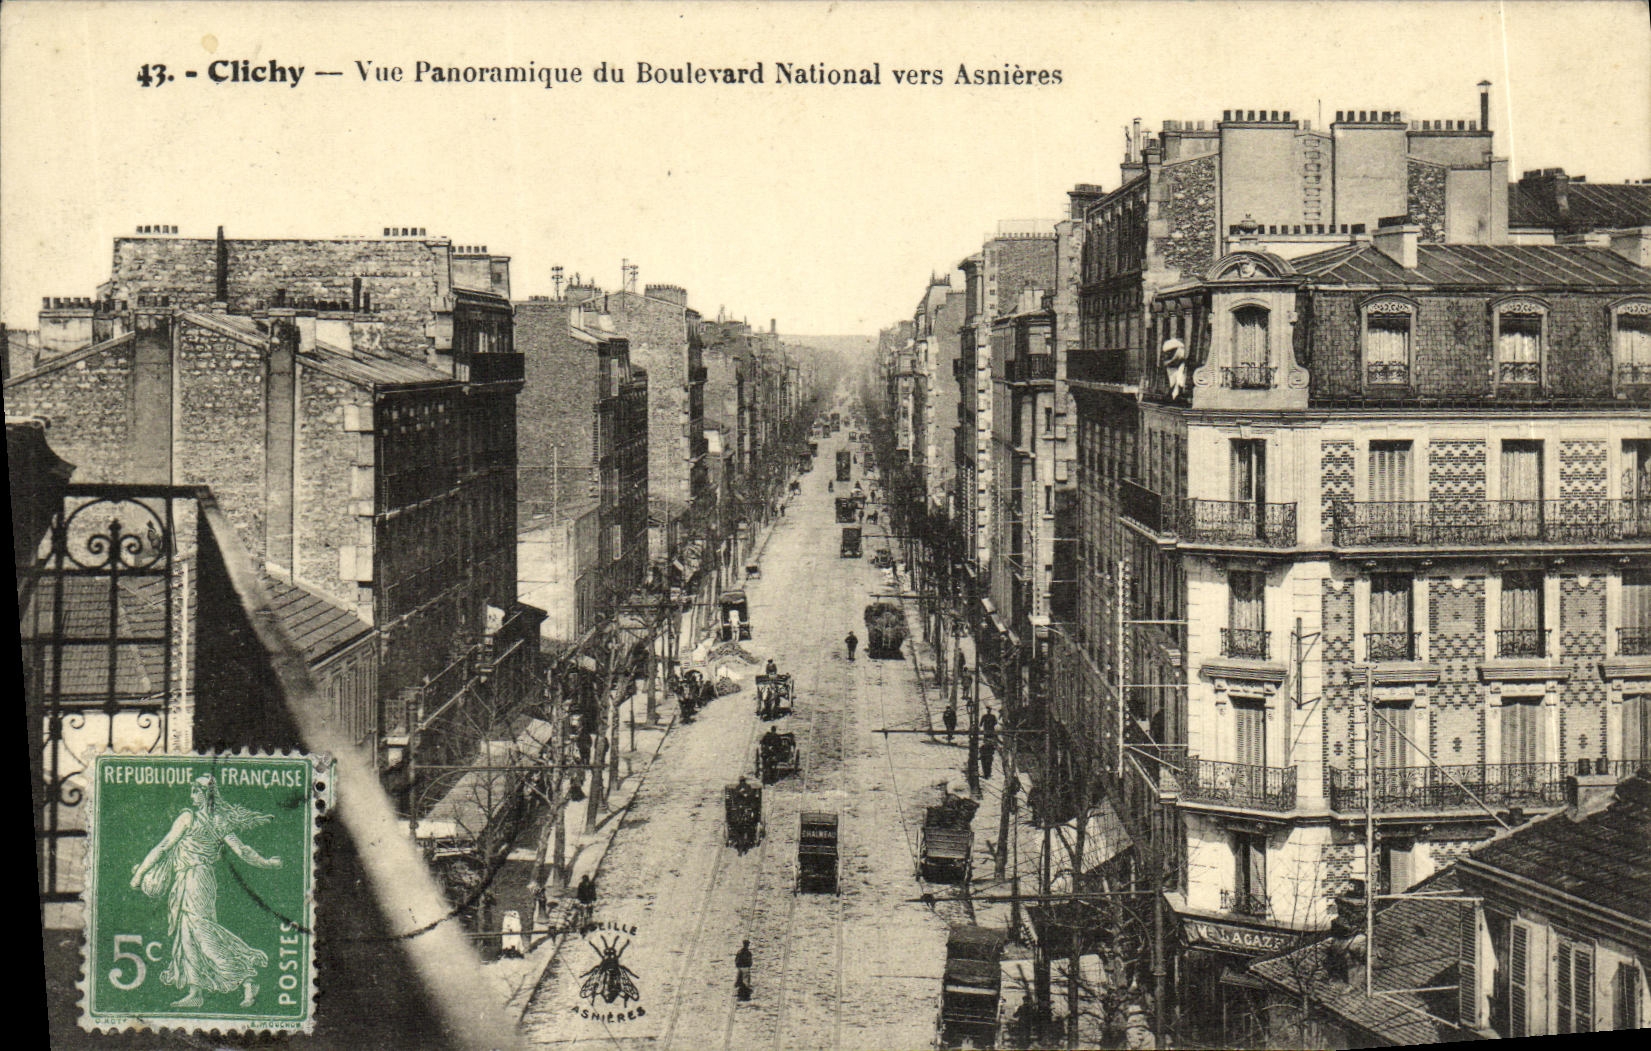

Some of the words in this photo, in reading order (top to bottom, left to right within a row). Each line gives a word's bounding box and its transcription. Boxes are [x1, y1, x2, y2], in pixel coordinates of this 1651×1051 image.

[104, 766, 193, 785] REPUBLIQUE
[221, 767, 302, 788] FRANÇAISE
[278, 921, 298, 1005] POSTES
